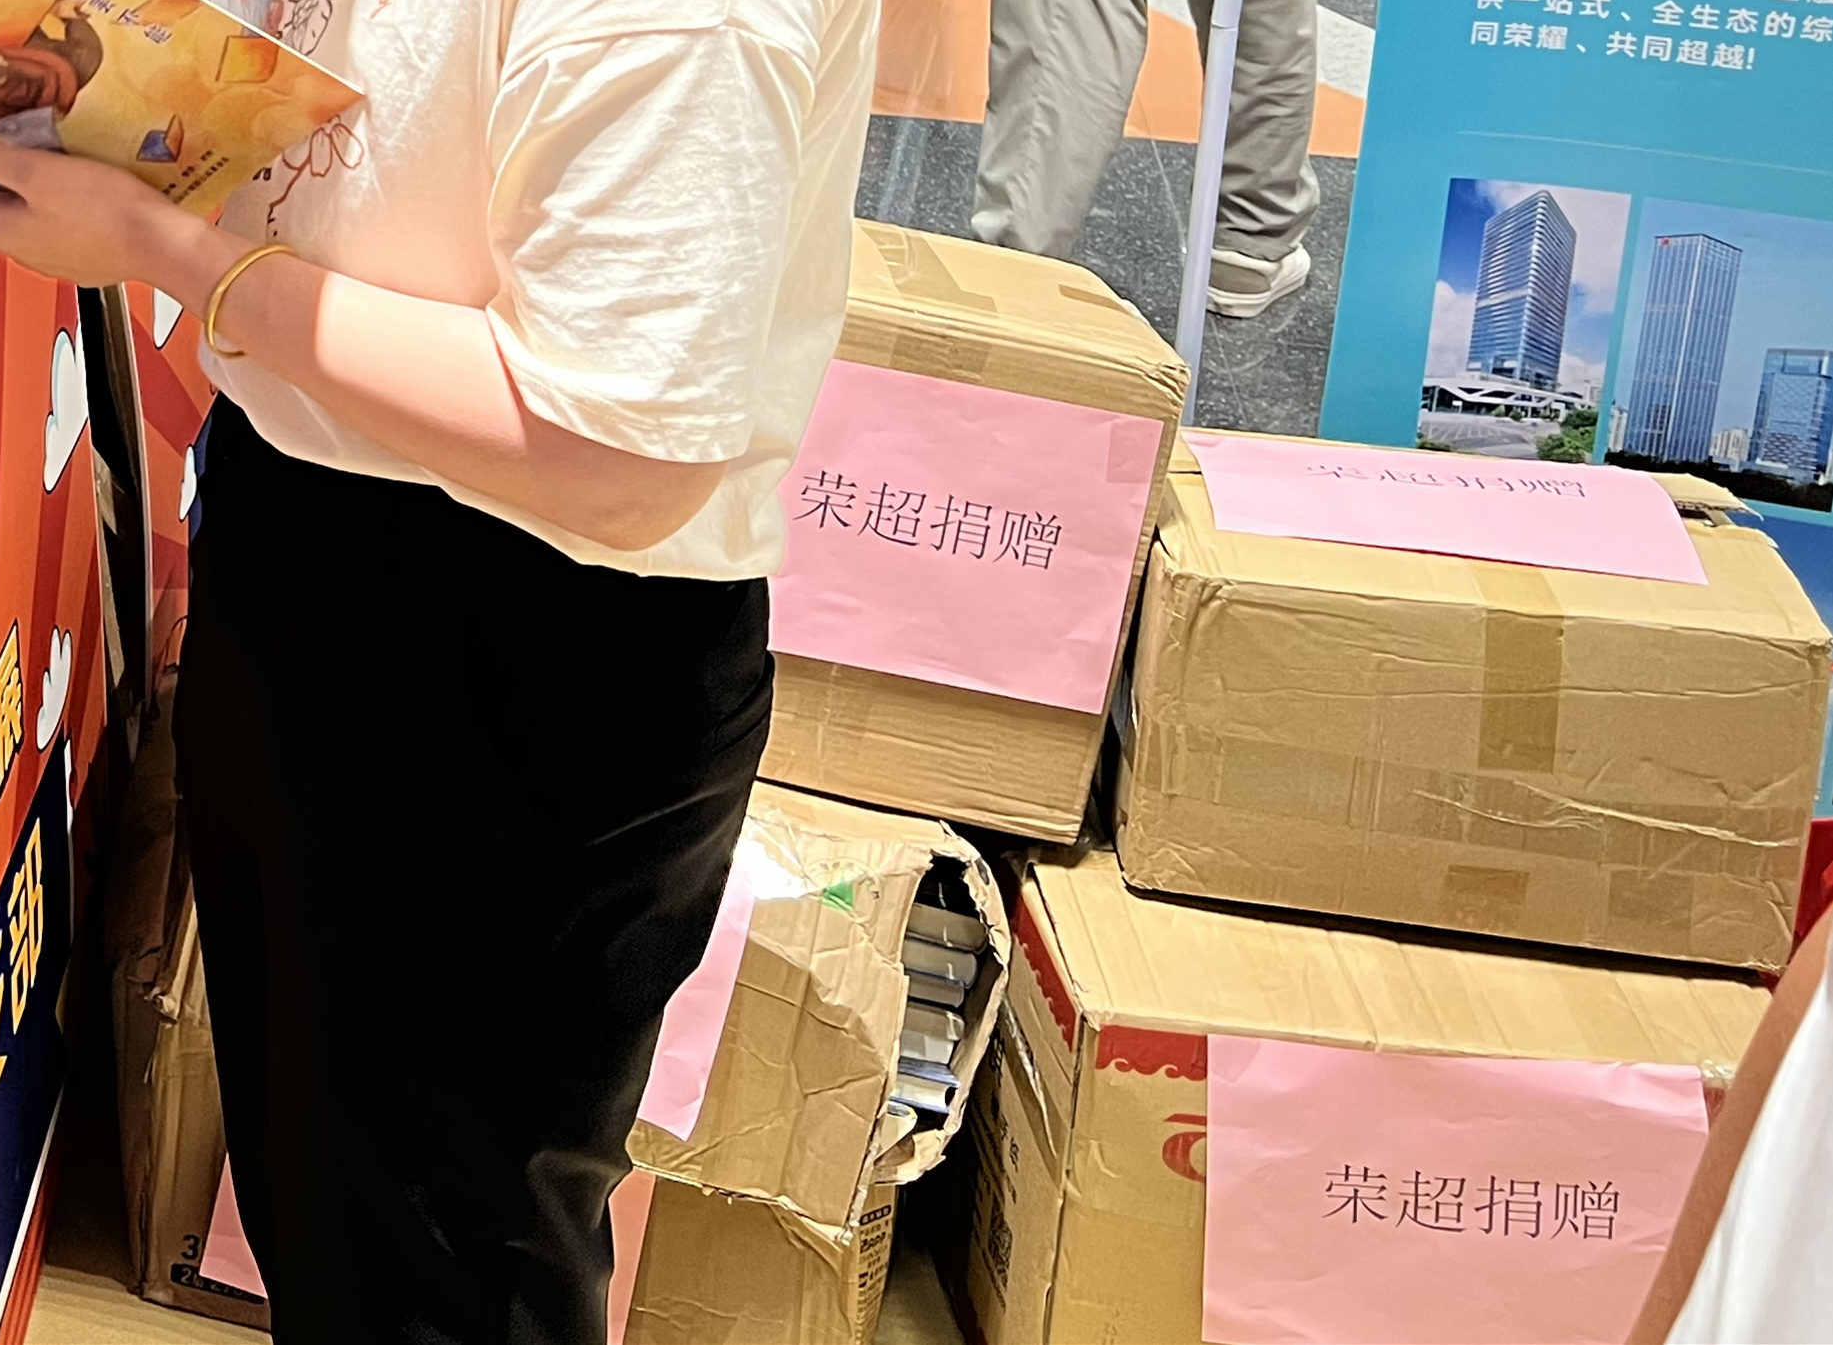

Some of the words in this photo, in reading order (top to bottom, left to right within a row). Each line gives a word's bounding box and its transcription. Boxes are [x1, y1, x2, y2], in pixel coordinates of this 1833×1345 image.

[792, 470, 1064, 572] 荣超捐赠
[1321, 1163, 1622, 1243] 荣超捐赠
